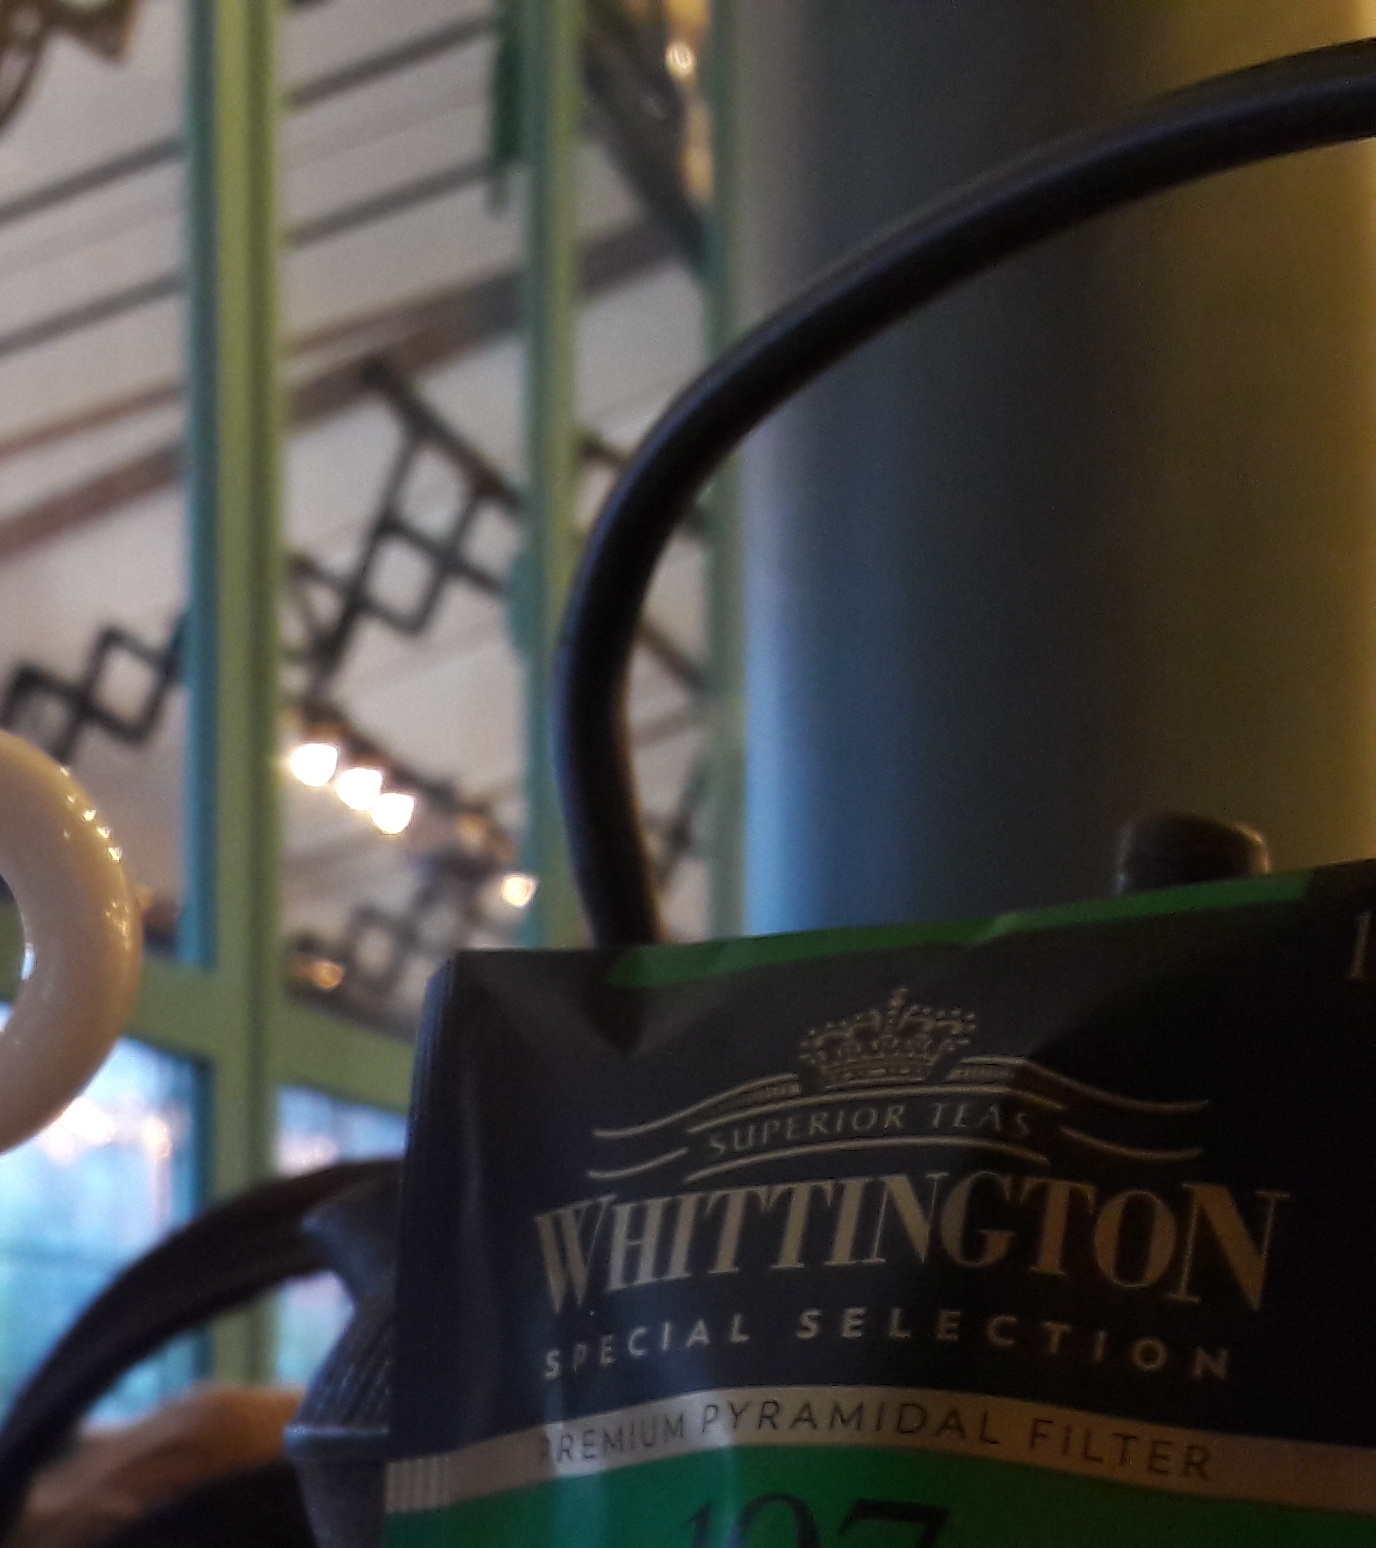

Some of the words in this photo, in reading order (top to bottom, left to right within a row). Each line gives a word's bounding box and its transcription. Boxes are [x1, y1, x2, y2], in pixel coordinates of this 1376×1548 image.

[708, 1102, 905, 1157] SUPERIOR
[930, 1101, 1032, 1139] TEAS
[533, 1168, 1291, 1313] WHITTINGTON
[544, 1310, 750, 1380] SPECIAL
[795, 1306, 1232, 1381] SELECTION
[538, 1413, 685, 1466] PREMIUM
[701, 1399, 1000, 1446] PYRAMIDAL
[1028, 1418, 1212, 1480] FILTER
